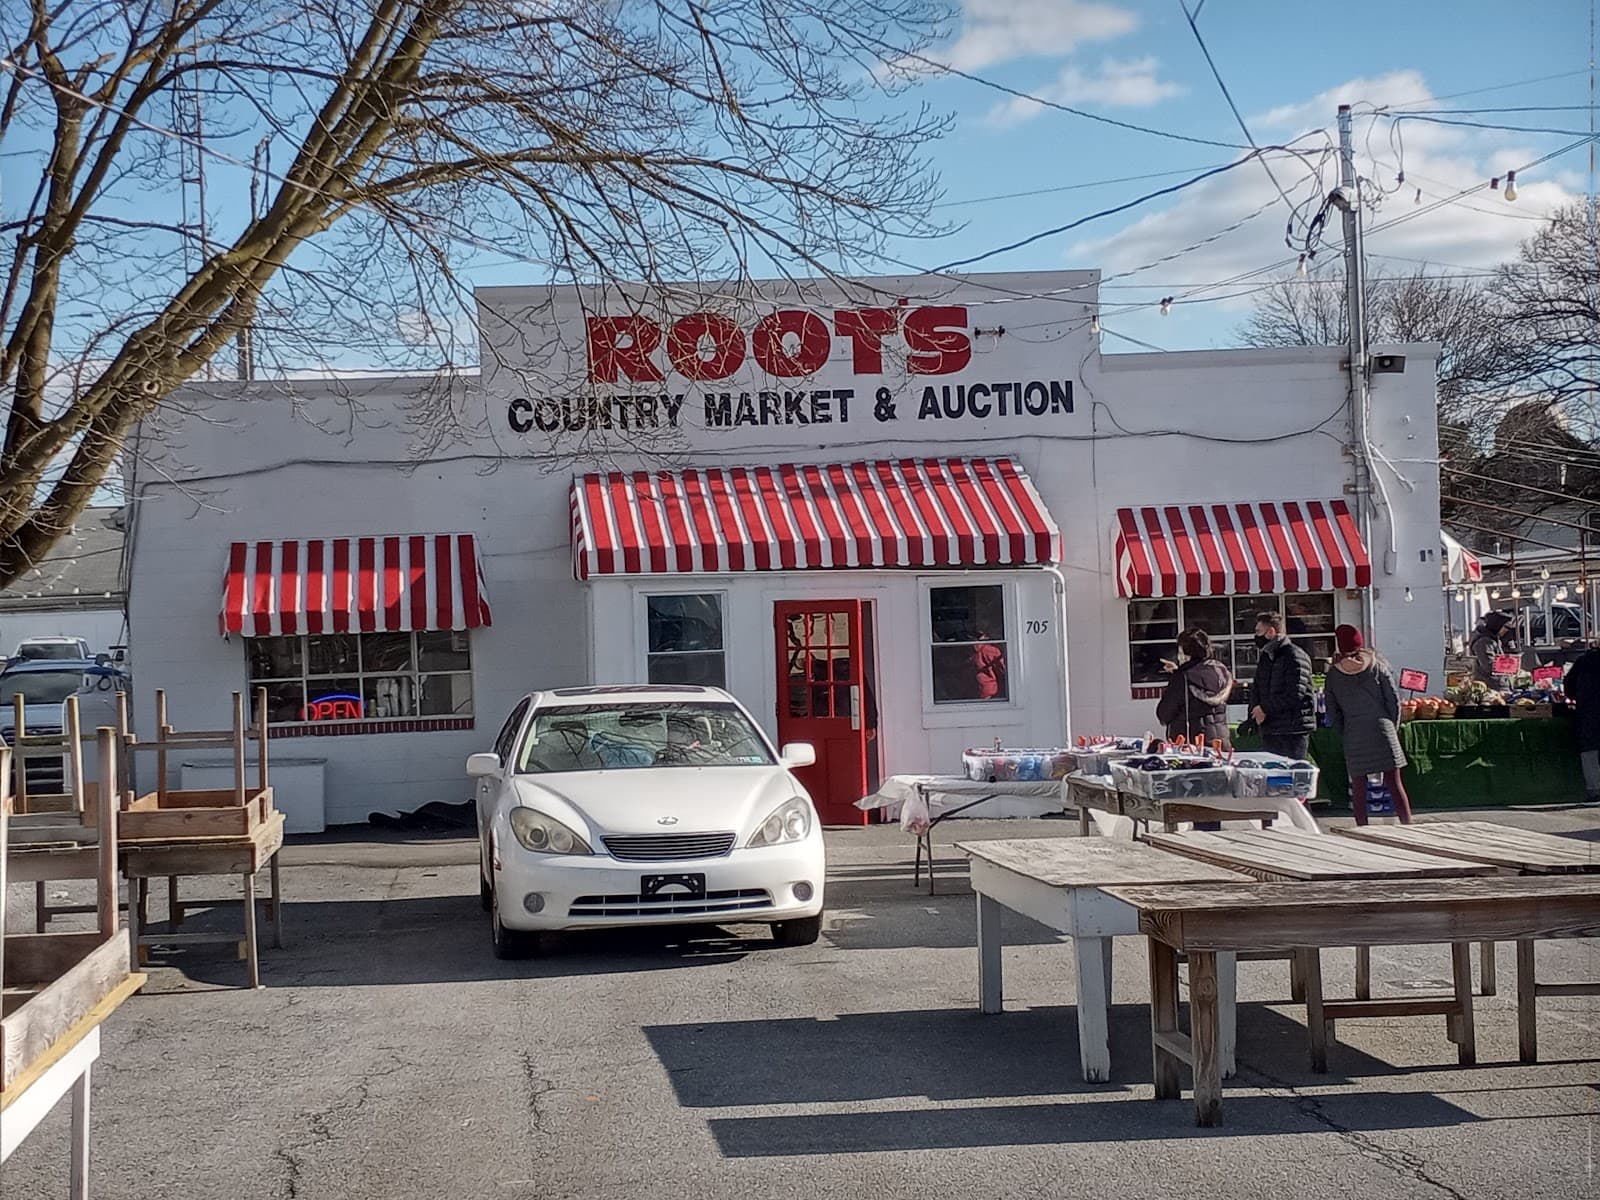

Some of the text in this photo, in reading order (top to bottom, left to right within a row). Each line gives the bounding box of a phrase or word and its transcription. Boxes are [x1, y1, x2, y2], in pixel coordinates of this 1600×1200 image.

[508, 381, 1074, 433] COUNTRY MARKET & AUCTION
[1026, 620, 1049, 634] 705
[302, 701, 362, 721] OPEN
